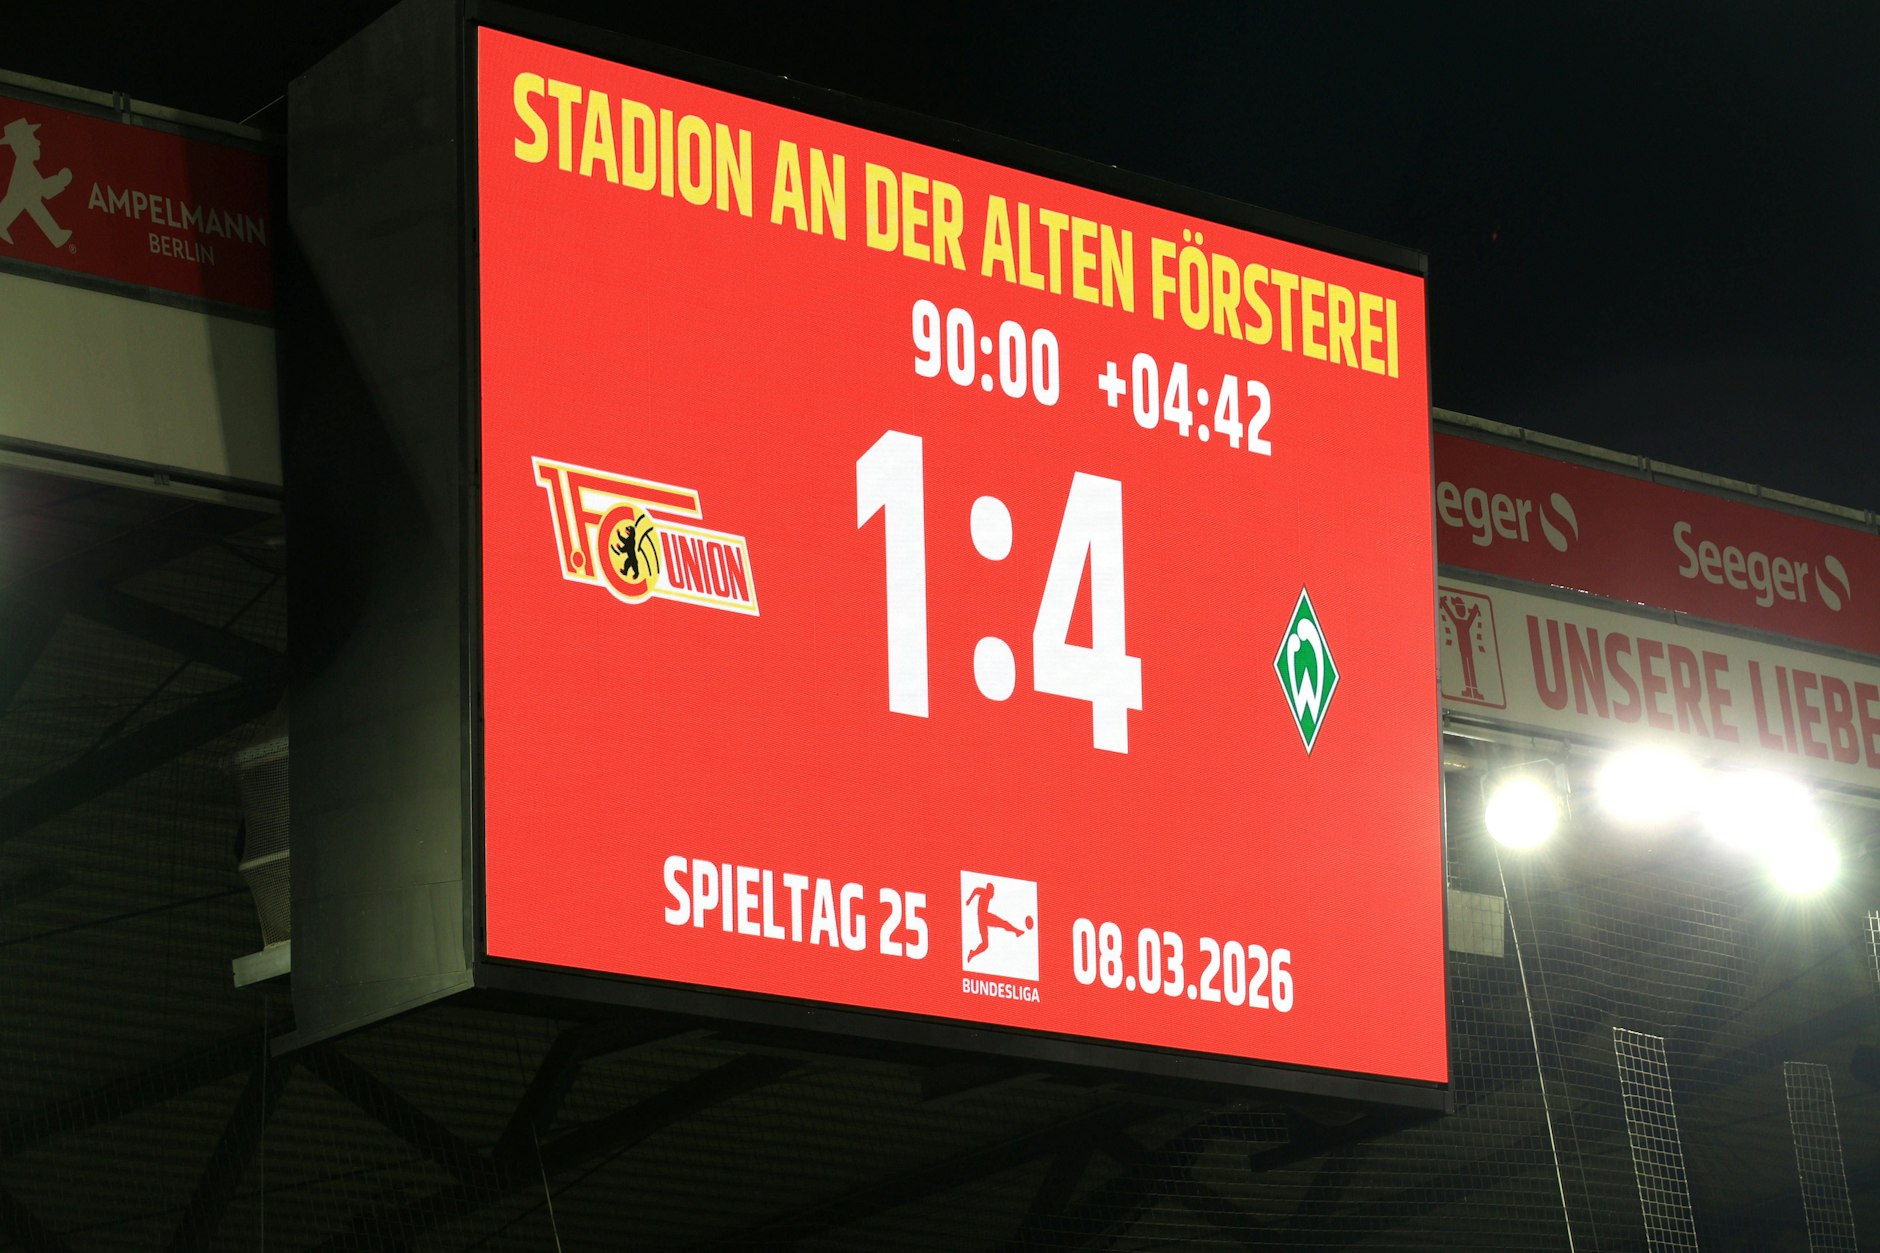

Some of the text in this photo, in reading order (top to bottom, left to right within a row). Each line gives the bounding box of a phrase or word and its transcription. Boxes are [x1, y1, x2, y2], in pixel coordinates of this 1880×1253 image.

[87, 181, 266, 246] AMPELMANN
[148, 232, 215, 266] BERLIN
[513, 72, 1399, 379] STADION AN DER ALTEN FÖRSTEREI
[911, 299, 1273, 457] 90:00 +04:42
[1436, 481, 1532, 547] eger
[660, 531, 750, 603] UNION
[1672, 520, 1810, 608] Seeger
[1525, 613, 1880, 770] UNSERE LIEBE
[663, 855, 929, 960] SPIELTAG 25
[962, 977, 1041, 1003] BUNDESLIGA
[1072, 917, 1294, 1013] 08.03.2026
